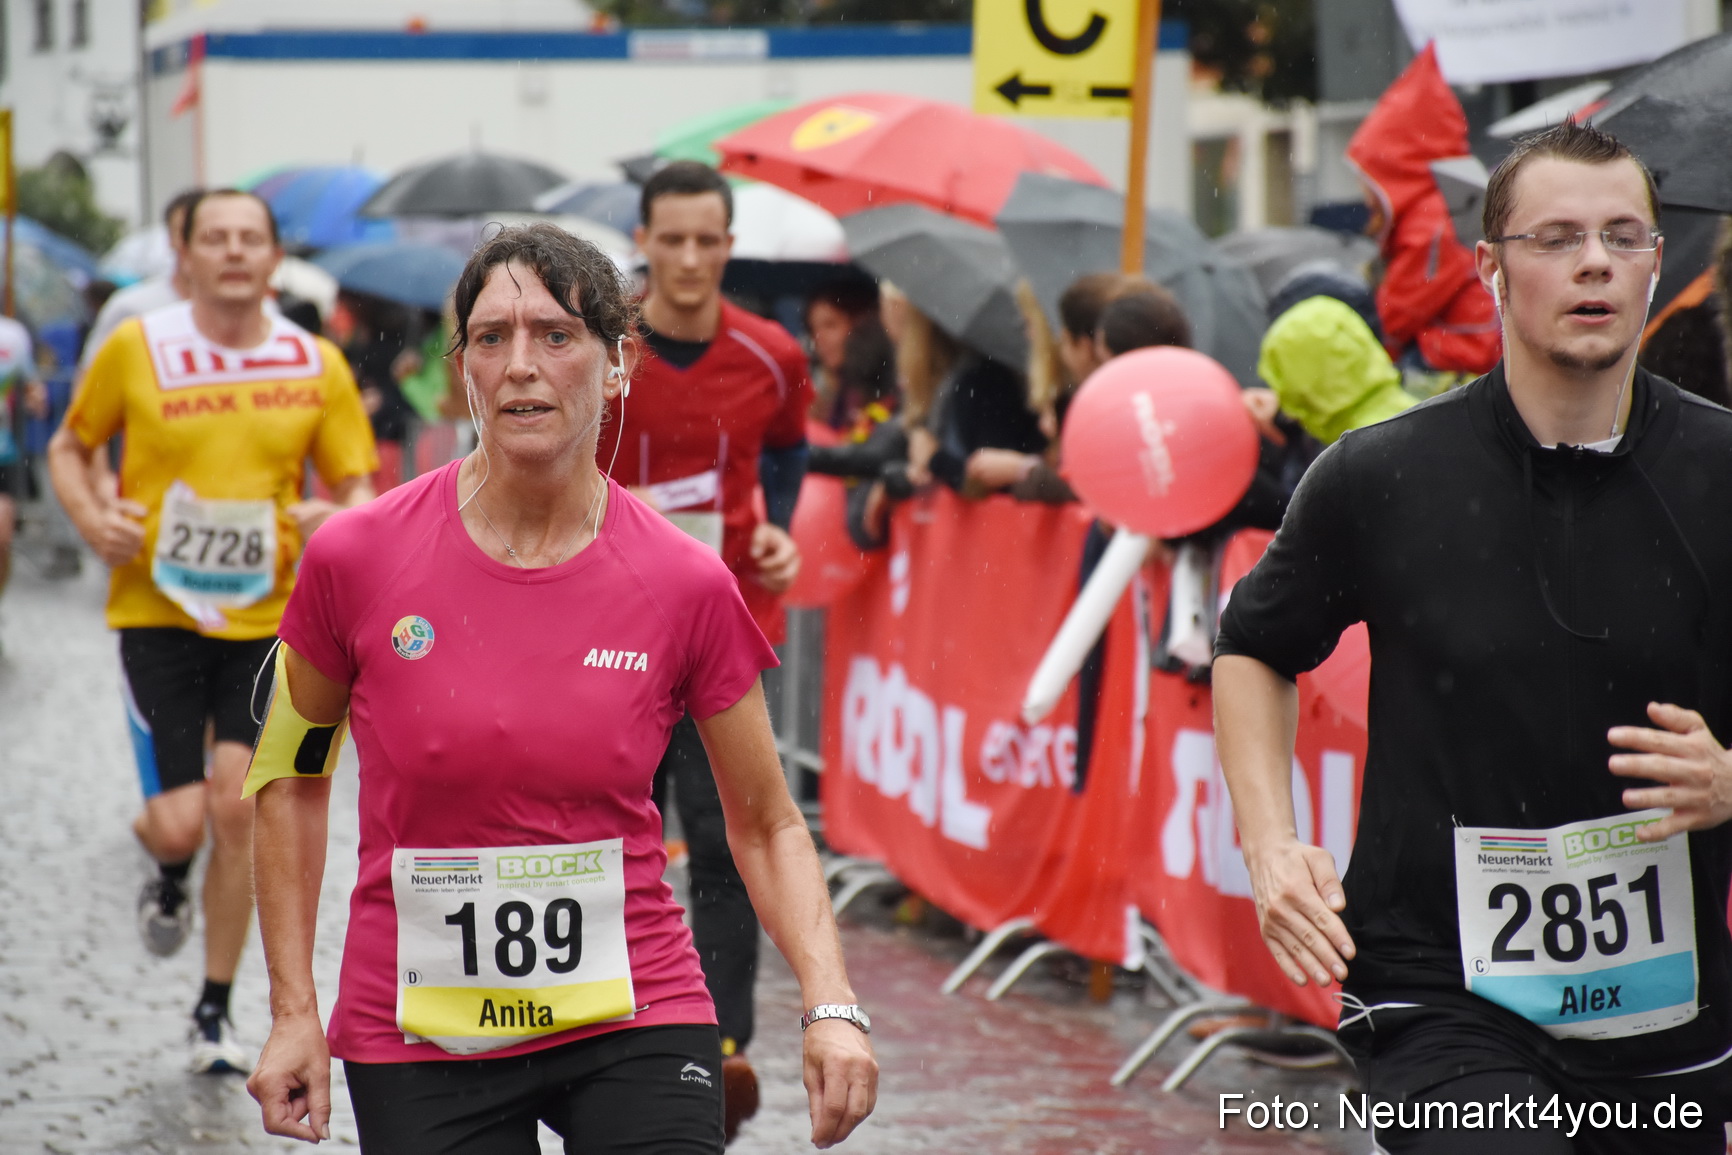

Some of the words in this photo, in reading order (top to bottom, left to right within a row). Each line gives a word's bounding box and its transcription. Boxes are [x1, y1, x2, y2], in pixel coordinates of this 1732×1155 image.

[1025, 0, 1108, 56] C
[163, 394, 238, 421] MAX
[169, 521, 265, 569] 2728
[583, 647, 648, 672] ANITA
[496, 849, 605, 880] BOCK
[1477, 853, 1553, 867] NeuerMarkt
[1604, 849, 1629, 860] smart
[1630, 843, 1670, 857] concepts
[411, 873, 483, 886] NeuerMarkt
[496, 881, 531, 891] inspired
[532, 880, 544, 890] by
[545, 876, 570, 888] smart
[571, 875, 606, 885] concepts
[1488, 864, 1665, 963] 2851
[444, 897, 583, 978] 189
[408, 971, 418, 984] D
[1475, 959, 1484, 973] C
[478, 998, 555, 1028] Anita
[1558, 984, 1622, 1017] Alex
